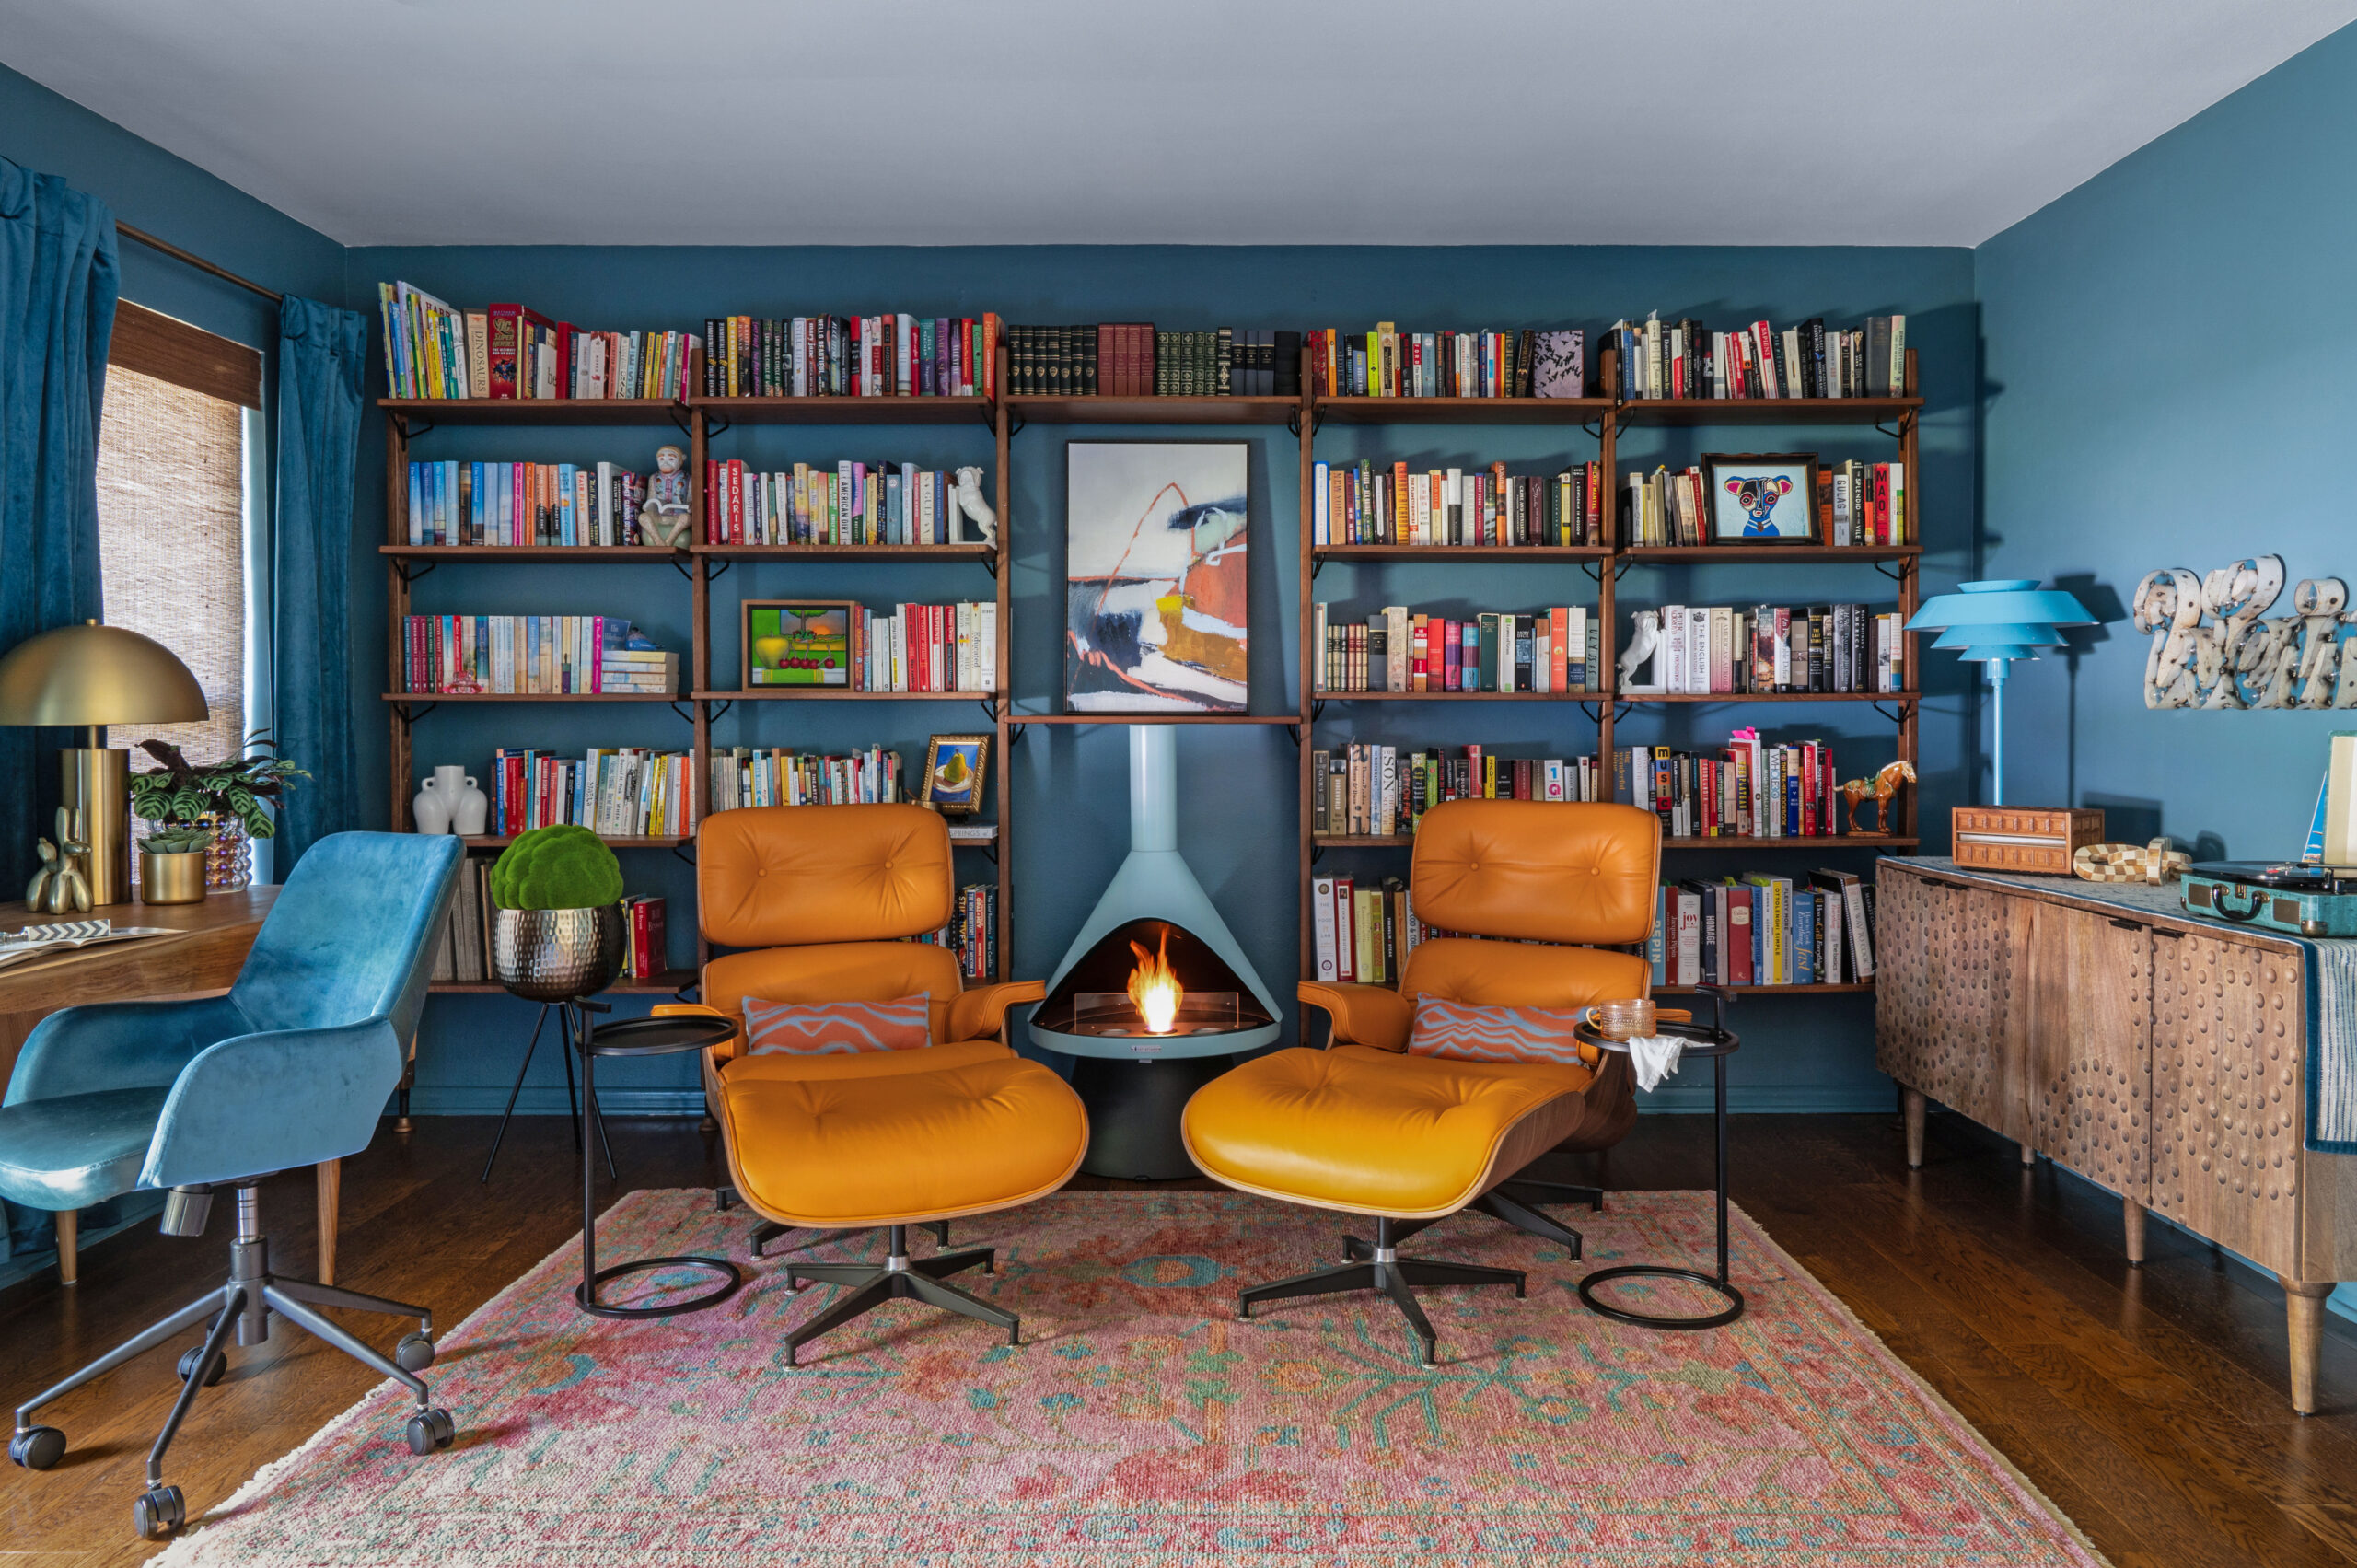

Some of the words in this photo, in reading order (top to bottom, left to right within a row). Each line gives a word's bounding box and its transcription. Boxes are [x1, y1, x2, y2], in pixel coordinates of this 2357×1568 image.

[1760, 327, 1771, 357] SAPIENS
[475, 331, 486, 392] DINOSAURS
[1333, 472, 1342, 492] NEW
[1836, 480, 1846, 509] GULAG
[1876, 470, 1887, 512] MAO
[731, 468, 740, 533] SEDARIS
[840, 482, 849, 517] AMERICAN
[1333, 495, 1342, 519] YORK
[840, 519, 849, 535] DIRT
[1588, 629, 1598, 675] ULYSSES
[1383, 756, 1395, 792] SON
[1402, 768, 1411, 787] CITY
[1618, 751, 1626, 791] wonderful
[1657, 748, 1670, 809] music
[812, 796, 818, 804] OF
[1402, 787, 1411, 800] ON
[1737, 778, 1747, 810] PLATEAU
[1402, 801, 1411, 819] FIRE
[1852, 899, 1860, 912] THE
[1706, 915, 1715, 946] HOMAGE
[1858, 931, 1866, 943] TO
[1860, 944, 1869, 964] COOK
